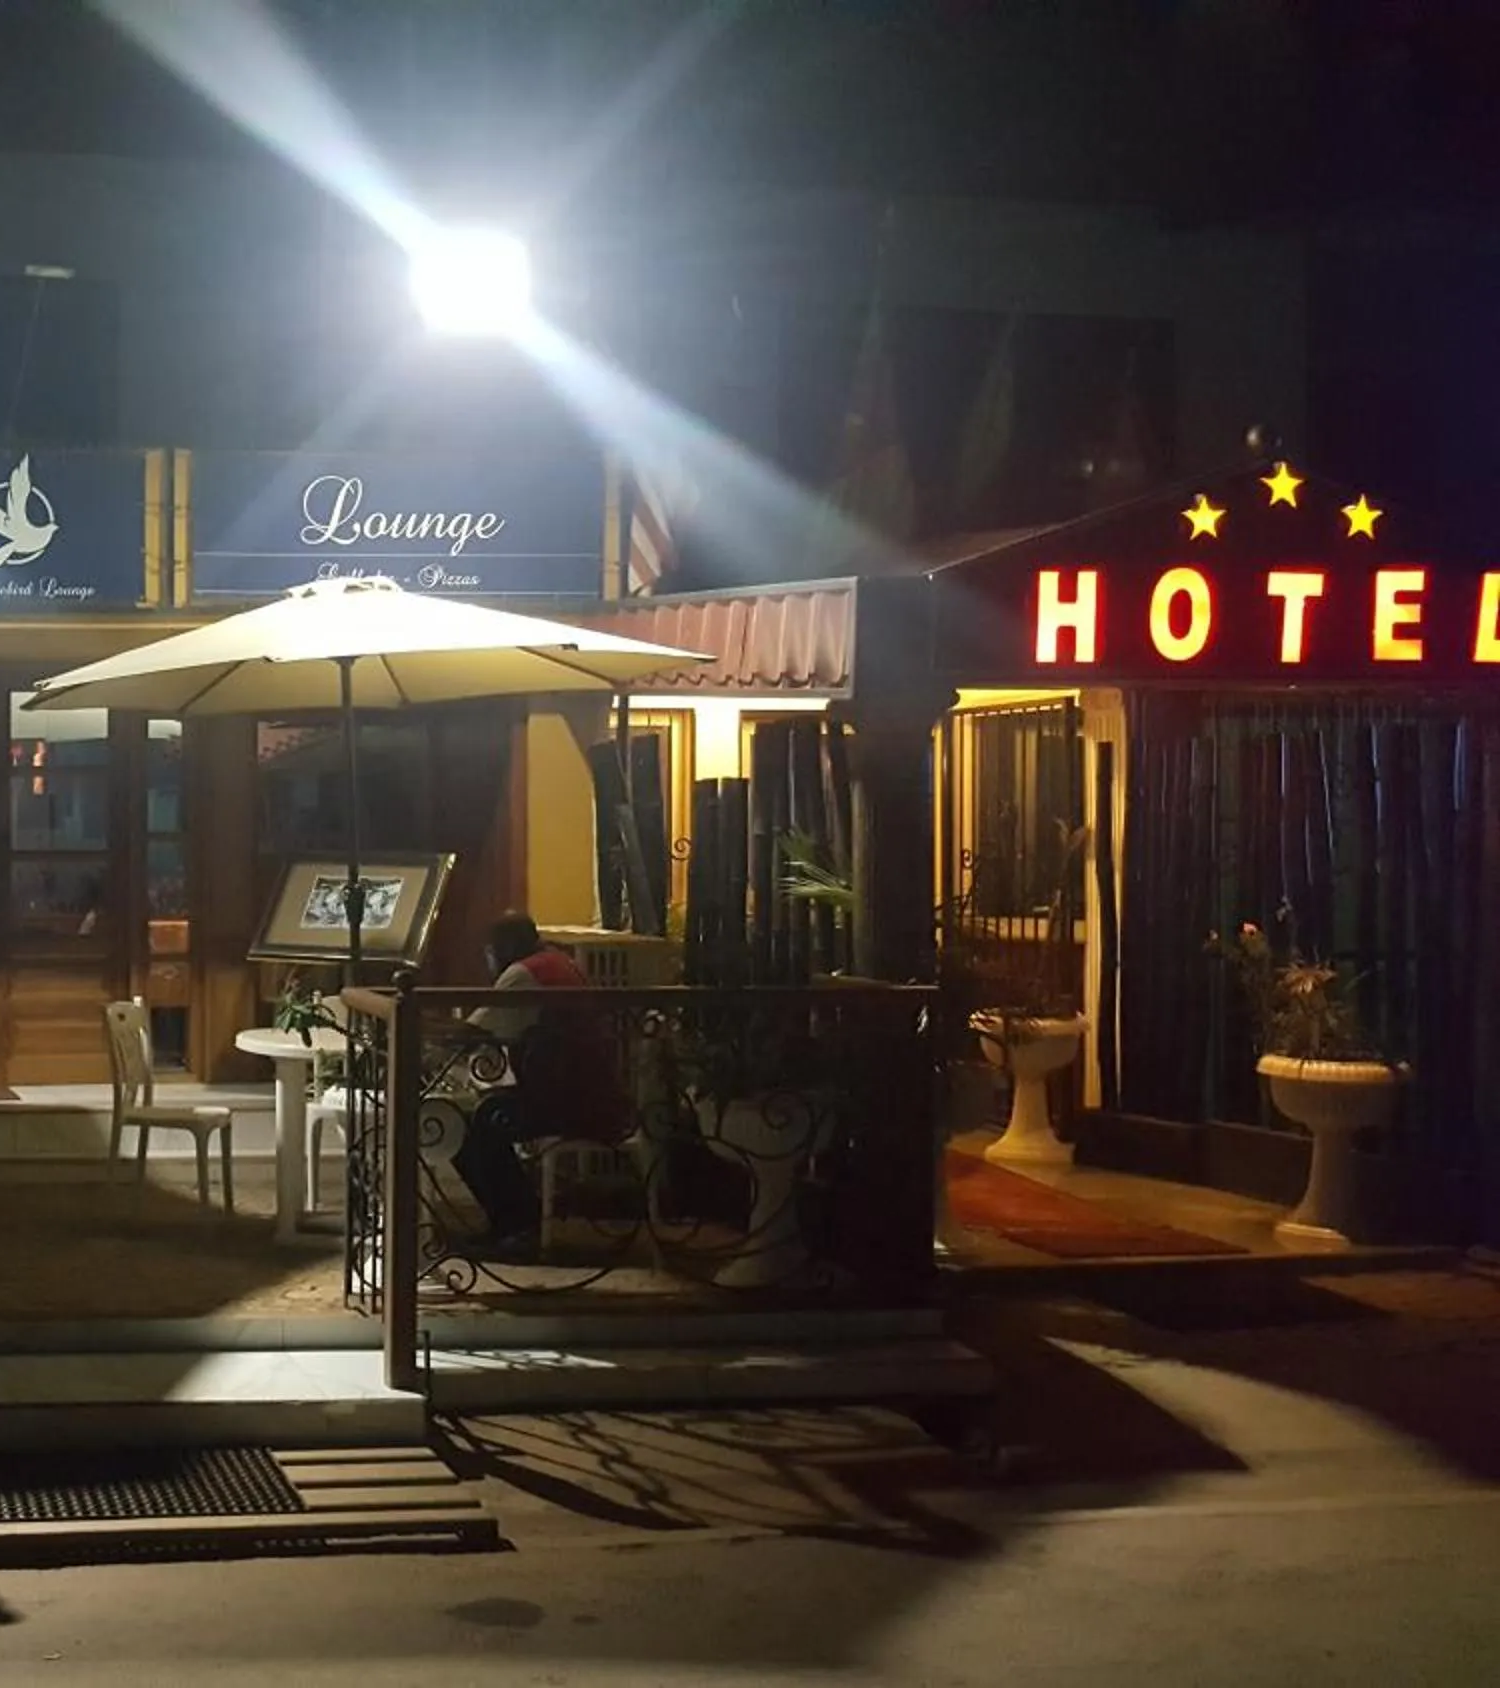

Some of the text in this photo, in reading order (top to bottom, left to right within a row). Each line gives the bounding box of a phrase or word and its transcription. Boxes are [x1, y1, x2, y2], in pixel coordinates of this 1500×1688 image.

[300, 475, 505, 556] Lounge
[39, 576, 96, 600] Lounge
[417, 563, 481, 588] Pizzas
[1035, 567, 1500, 664] HOTEL
